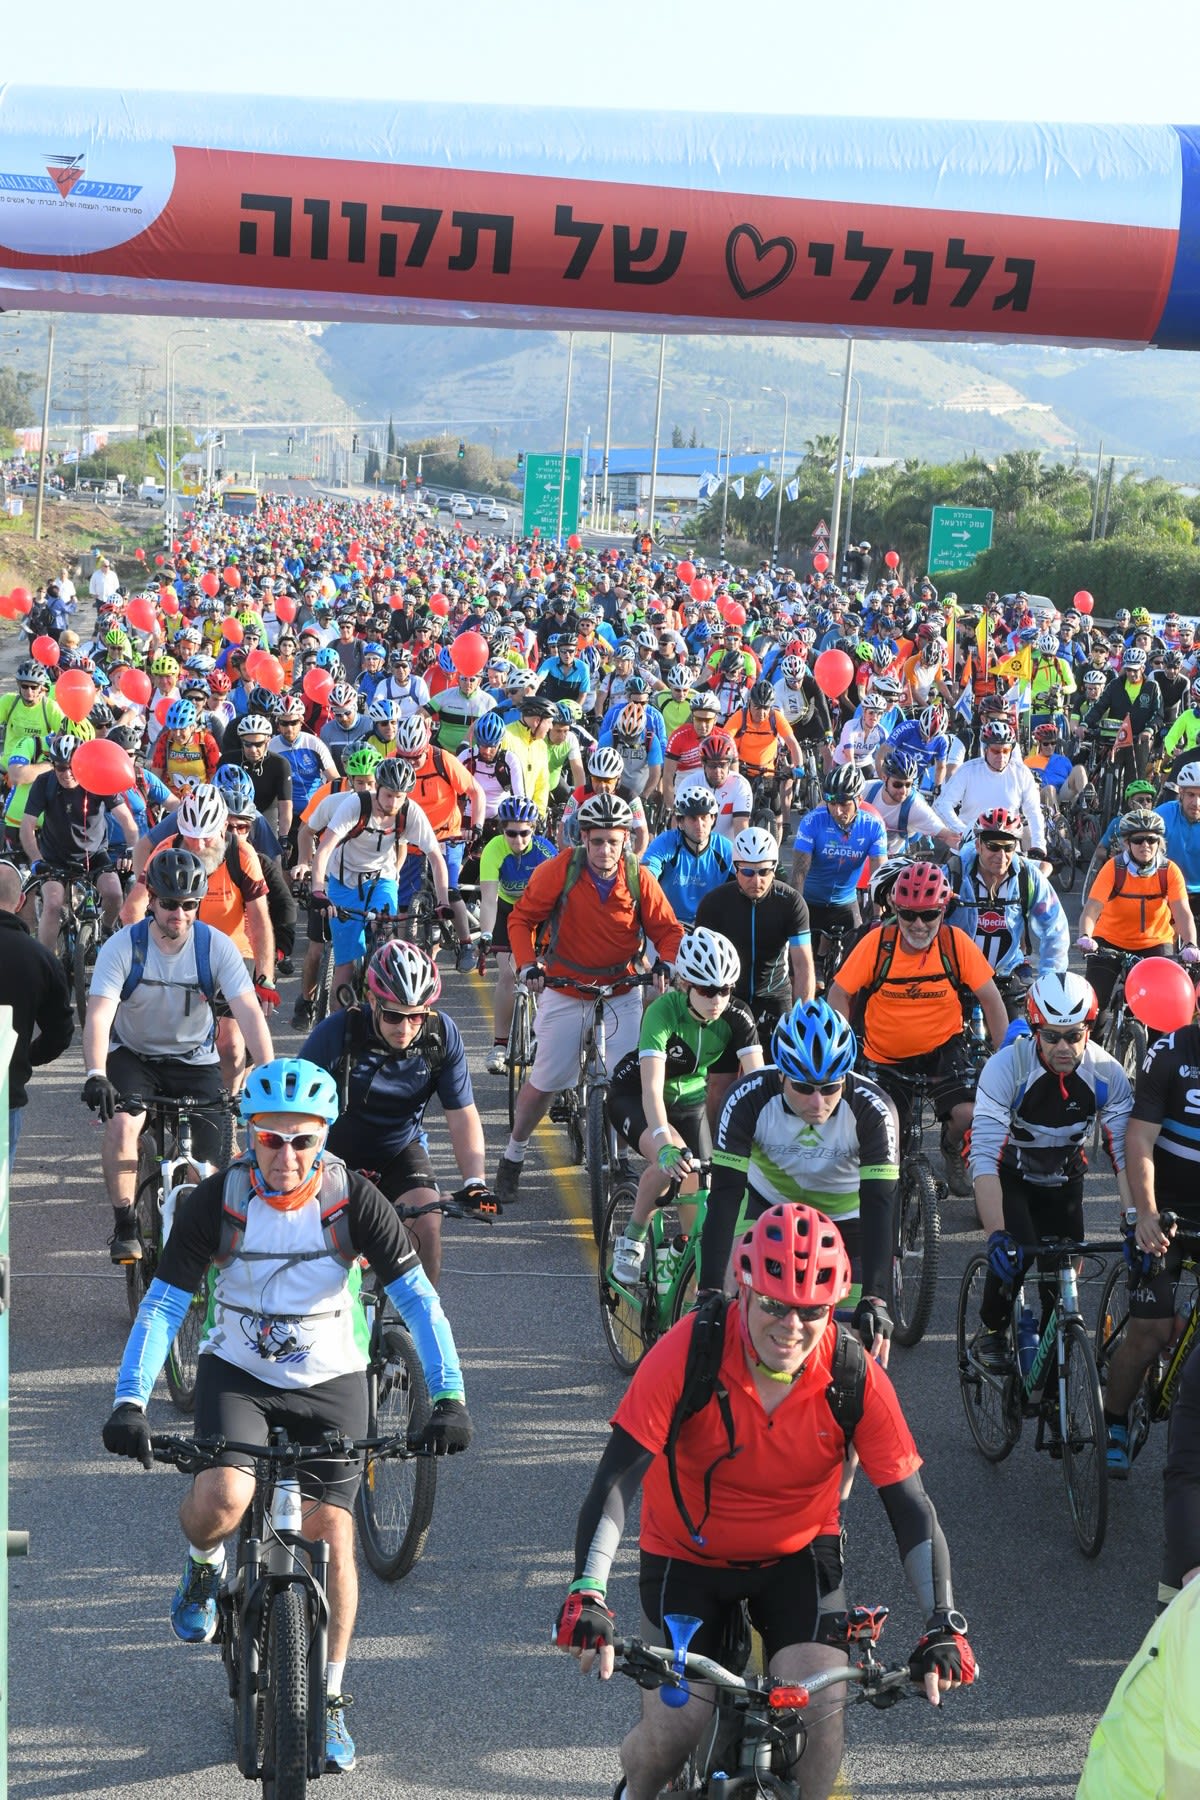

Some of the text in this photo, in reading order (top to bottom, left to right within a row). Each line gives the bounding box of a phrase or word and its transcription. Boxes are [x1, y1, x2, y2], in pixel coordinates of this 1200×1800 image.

[75, 182, 136, 199] אתגרים
[6, 196, 25, 204] אנשים
[78, 202, 99, 210] העצמה
[123, 207, 143, 215] ספורט
[239, 192, 1036, 313] גלגלי של תקווה
[940, 519, 985, 528] עמק יזרעאל
[933, 558, 954, 567] Emeq
[891, 722, 916, 741] ISRAEL
[822, 847, 865, 858] ACADEMY
[978, 917, 1006, 928] Alpecin
[717, 1075, 764, 1151] MERIDA
[854, 1086, 897, 1163] MERIDA
